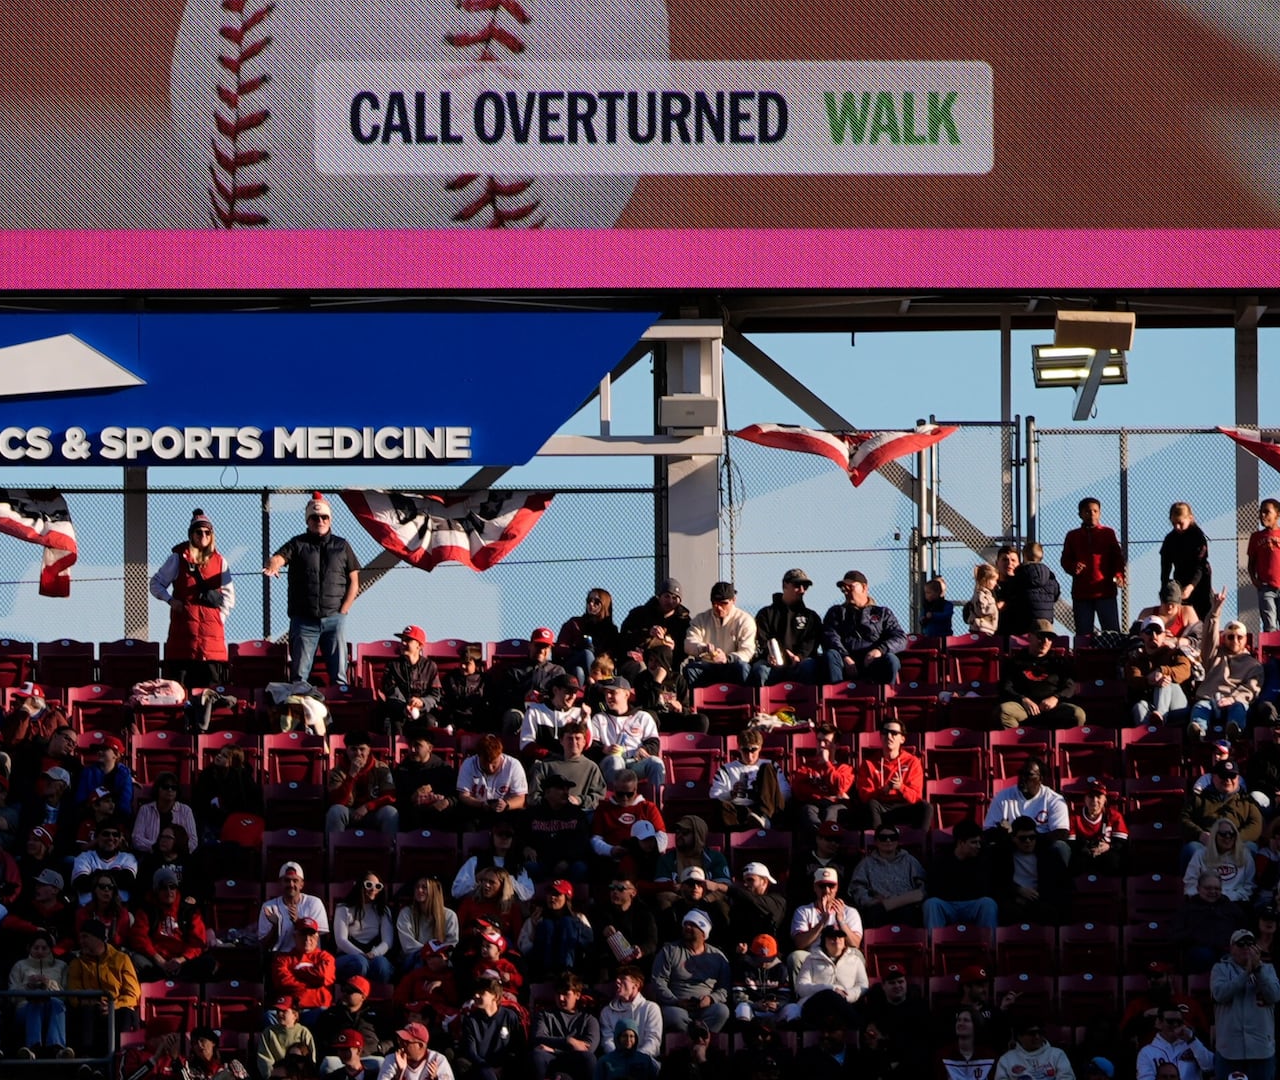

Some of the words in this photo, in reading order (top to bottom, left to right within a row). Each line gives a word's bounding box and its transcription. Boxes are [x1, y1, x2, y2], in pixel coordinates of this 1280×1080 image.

[350, 90, 462, 146] CALL
[473, 90, 790, 146] OVERTURNED
[823, 90, 960, 146] WALK
[60, 428, 91, 460] &
[100, 427, 264, 461] SPORTS
[273, 427, 472, 461] MEDICINE
